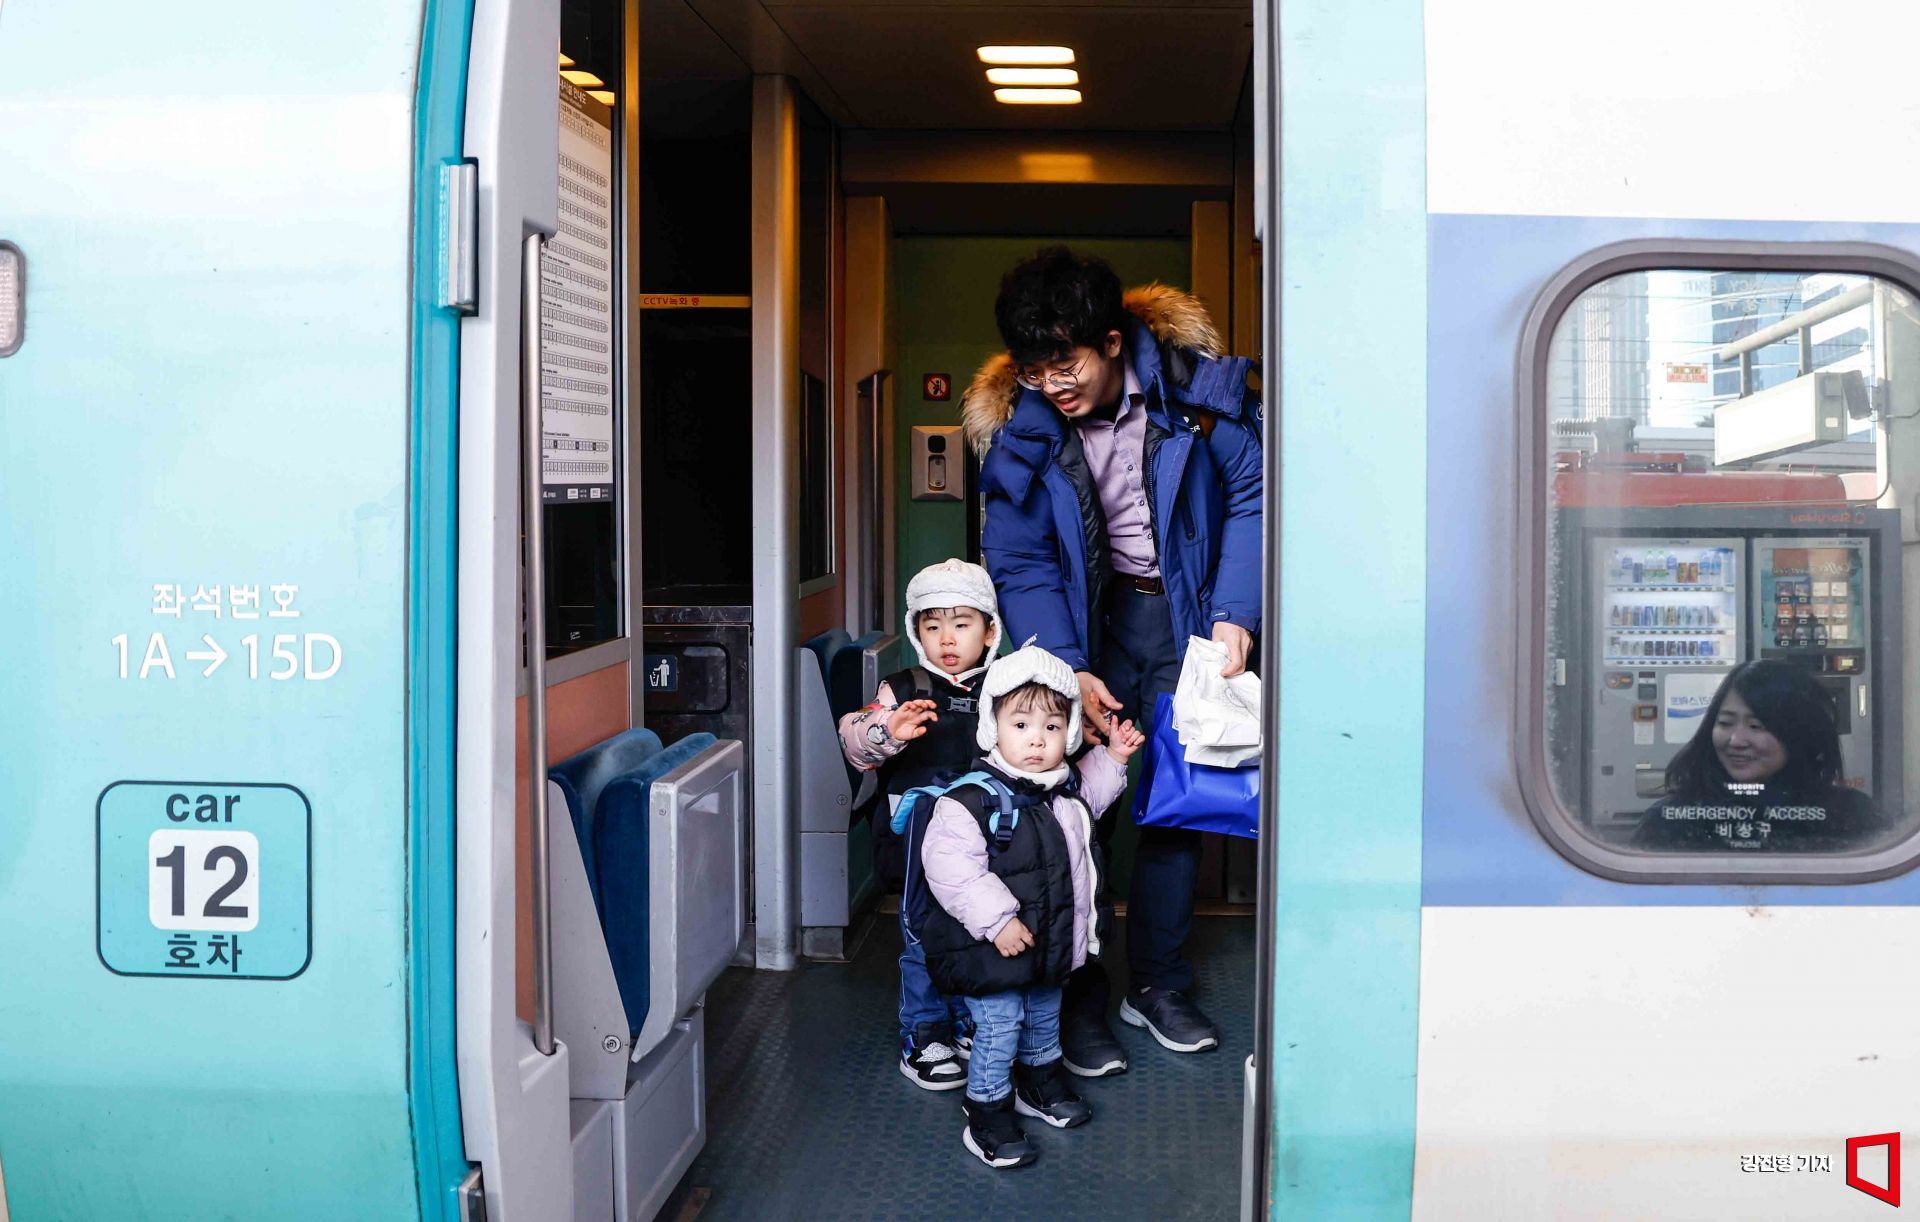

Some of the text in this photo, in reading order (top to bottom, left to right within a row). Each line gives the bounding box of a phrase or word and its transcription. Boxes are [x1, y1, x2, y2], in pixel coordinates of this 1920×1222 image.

[152, 583, 303, 619] 좌석번호
[110, 633, 343, 681] 1A 15D
[165, 793, 241, 824] car
[1664, 807, 1827, 821] EMERGENCY ACCESS
[1718, 823, 1772, 838] 비상구
[156, 846, 249, 919] 12
[164, 934, 243, 972] 호차
